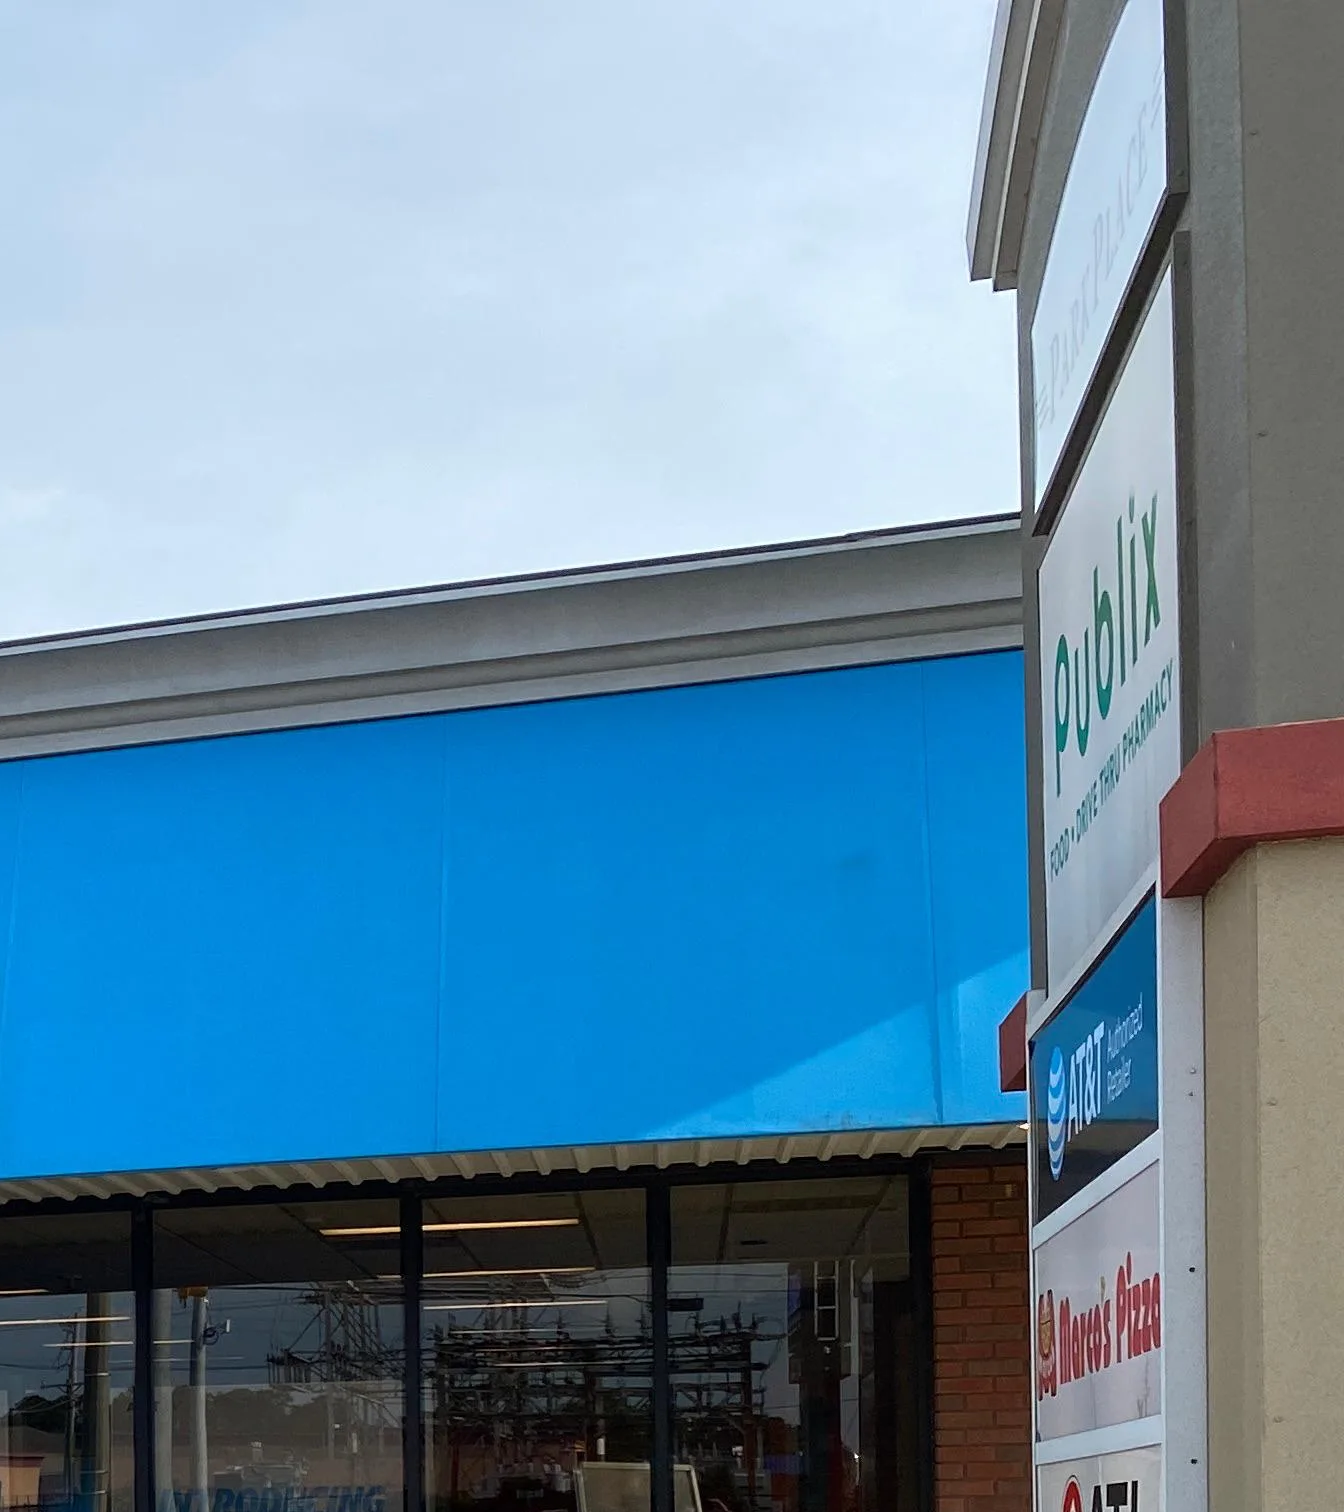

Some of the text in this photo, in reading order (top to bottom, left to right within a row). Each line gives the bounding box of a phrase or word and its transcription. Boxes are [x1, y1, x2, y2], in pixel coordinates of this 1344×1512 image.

[1092, 102, 1148, 314] PLACE
[1050, 658, 1174, 882] FOOD DRIVE THRU PHARMACY
[1067, 1020, 1105, 1143] AT&T
[1059, 1251, 1161, 1385] Marco's Pizza
